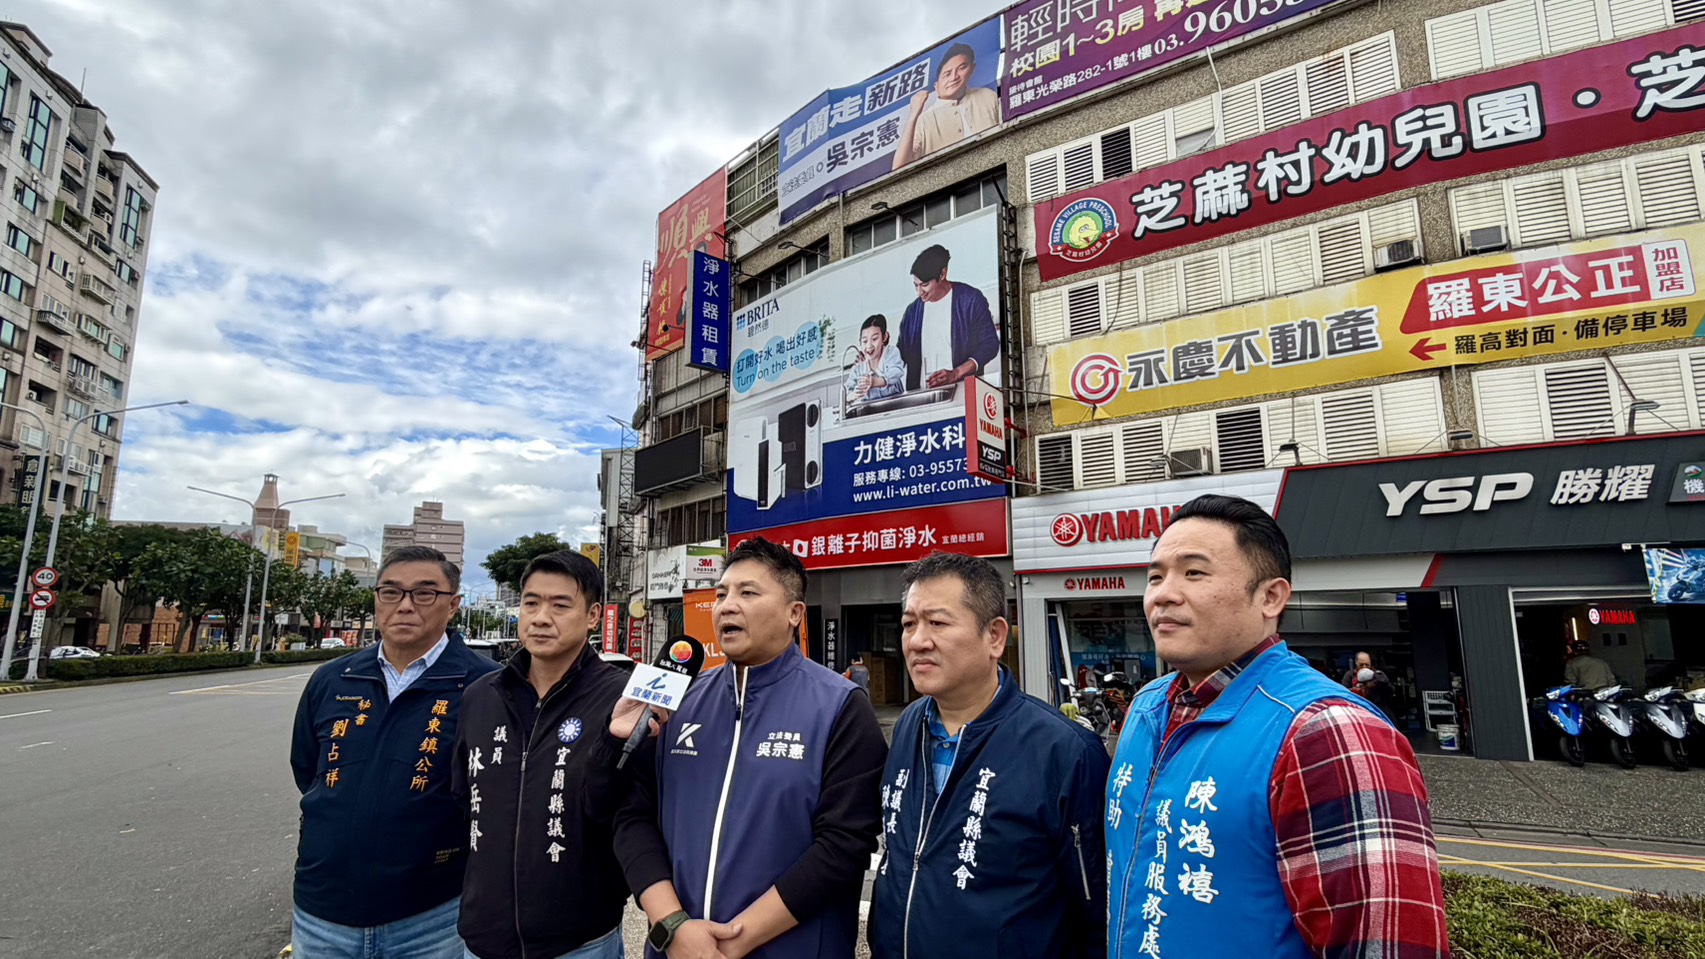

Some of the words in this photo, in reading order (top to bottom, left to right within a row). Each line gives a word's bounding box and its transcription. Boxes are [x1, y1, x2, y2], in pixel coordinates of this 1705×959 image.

[1010, 0, 1130, 52] 輕時
[1008, 75, 1044, 96] 接待會館
[826, 116, 901, 174] 吳宗憲
[1062, 201, 1088, 219] VILLAGE
[1089, 201, 1113, 229] PRESCHOOL
[1427, 254, 1641, 322] 羅東公正
[1653, 246, 1686, 293] 加盟店
[700, 256, 721, 367] 淨水器租賃
[747, 298, 780, 326] BRITA
[736, 347, 772, 374] 打開好水
[776, 325, 818, 356] 喝出好感
[736, 372, 756, 387] Turn
[758, 367, 770, 379] on
[771, 359, 787, 374] the
[789, 348, 815, 367] taste
[1126, 306, 1380, 391] 永慶不動產
[979, 418, 1004, 441] YAMAHA
[982, 445, 1002, 462] YSP
[853, 475, 992, 503] www.li-water.com.tw
[1378, 472, 1534, 517] YSP
[1550, 464, 1656, 506] 勝耀
[811, 524, 937, 557] 銀離子抑菌淨水
[37, 572, 54, 580] 40
[698, 558, 713, 567] 3M
[1077, 576, 1126, 591] YAMAHA
[1600, 609, 1637, 625] YAMAHA
[631, 686, 673, 706] 宜蘭新聞
[325, 718, 350, 789] 劉占祥
[409, 699, 449, 792] 羅東鎮公所
[490, 725, 508, 765] 議員
[756, 741, 805, 760] 吳宗憲
[545, 746, 572, 863] 宜蘭縣議會
[951, 767, 996, 891] 宜蘭縣議會
[1177, 775, 1220, 905] 陳鴻禧
[1138, 798, 1173, 959] 議員服務處
